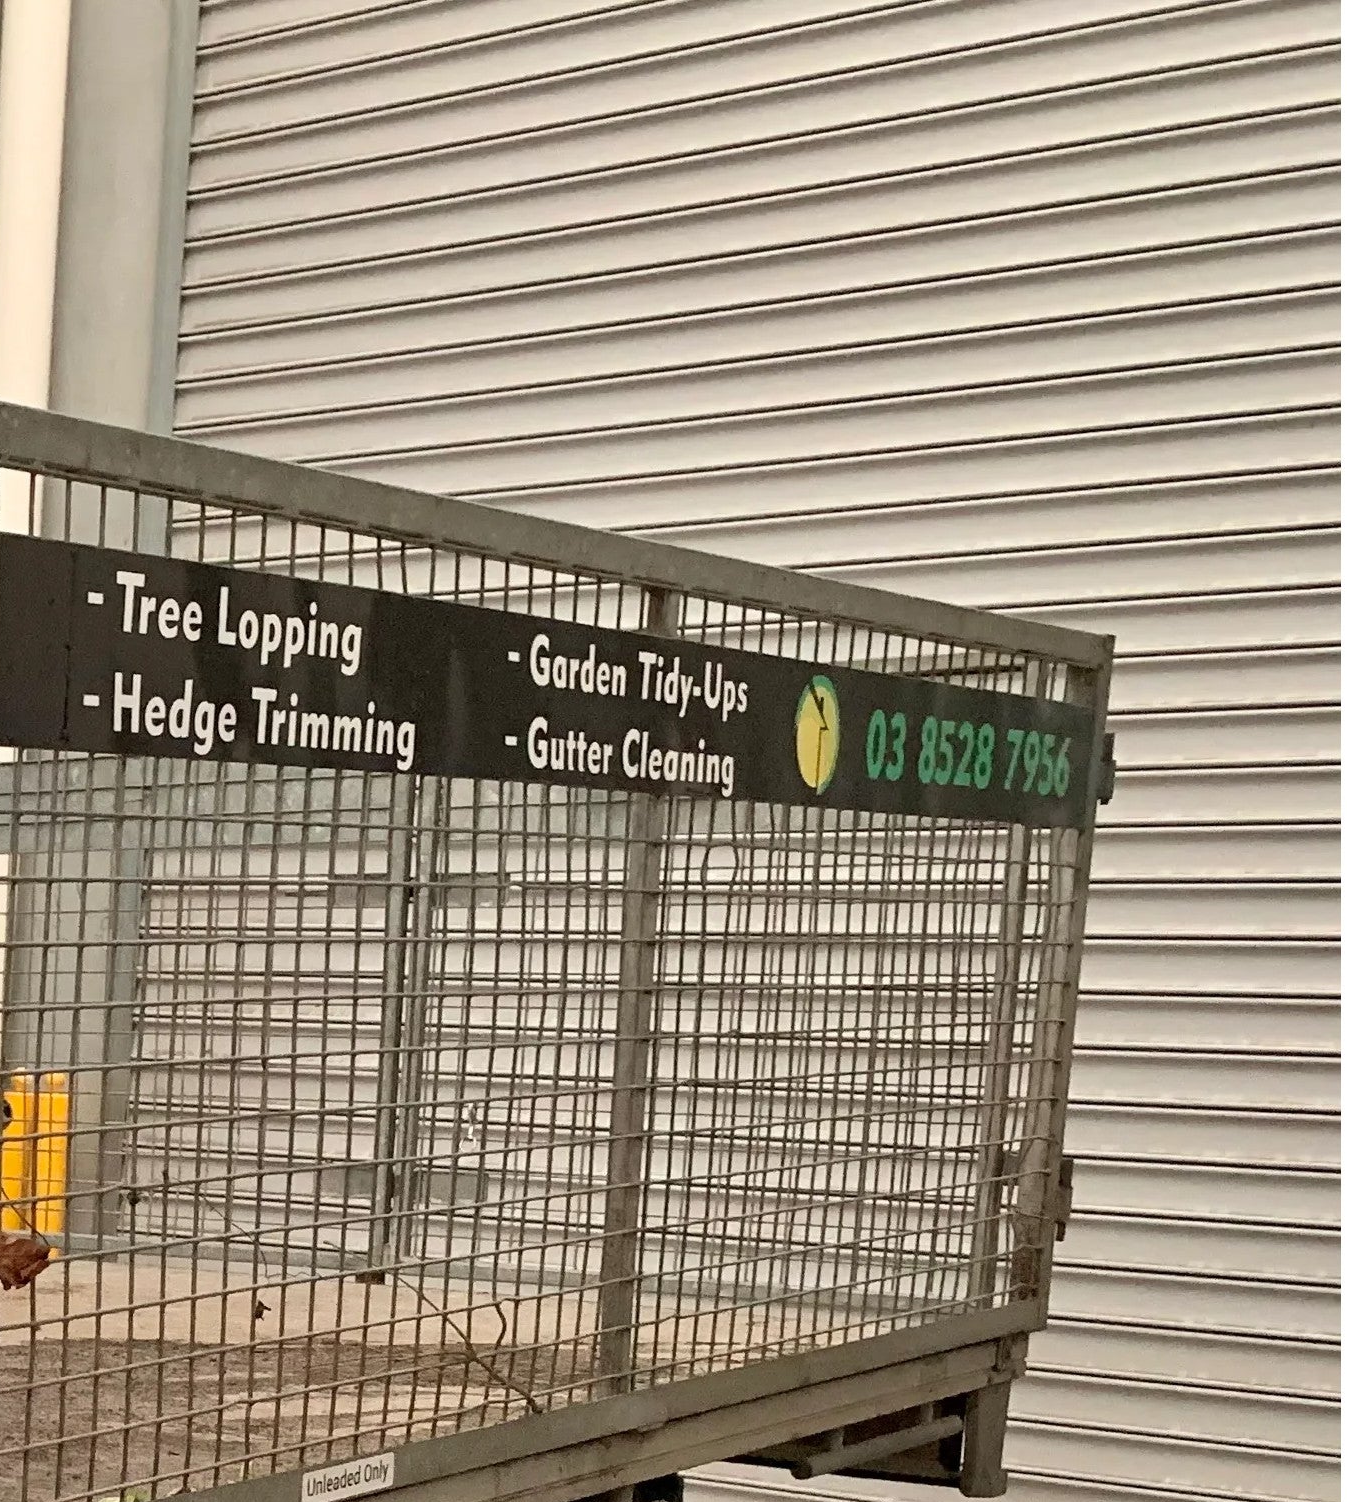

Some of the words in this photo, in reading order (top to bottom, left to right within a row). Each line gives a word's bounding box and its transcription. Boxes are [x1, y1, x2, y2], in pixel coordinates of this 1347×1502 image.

[116, 571, 202, 641] Tree
[218, 586, 363, 676] Lopping
[113, 671, 236, 755] Hedge
[252, 687, 416, 771] Trimming
[530, 634, 627, 697] Garden
[638, 651, 748, 722] Tidy-Ups
[527, 716, 613, 775] Gutter
[622, 728, 735, 797] Cleaning
[866, 709, 907, 782] 03
[917, 716, 996, 790] 8528
[1003, 729, 1072, 797] 7956
[307, 1465, 361, 1497] Unleaded
[364, 1460, 389, 1483] Only
